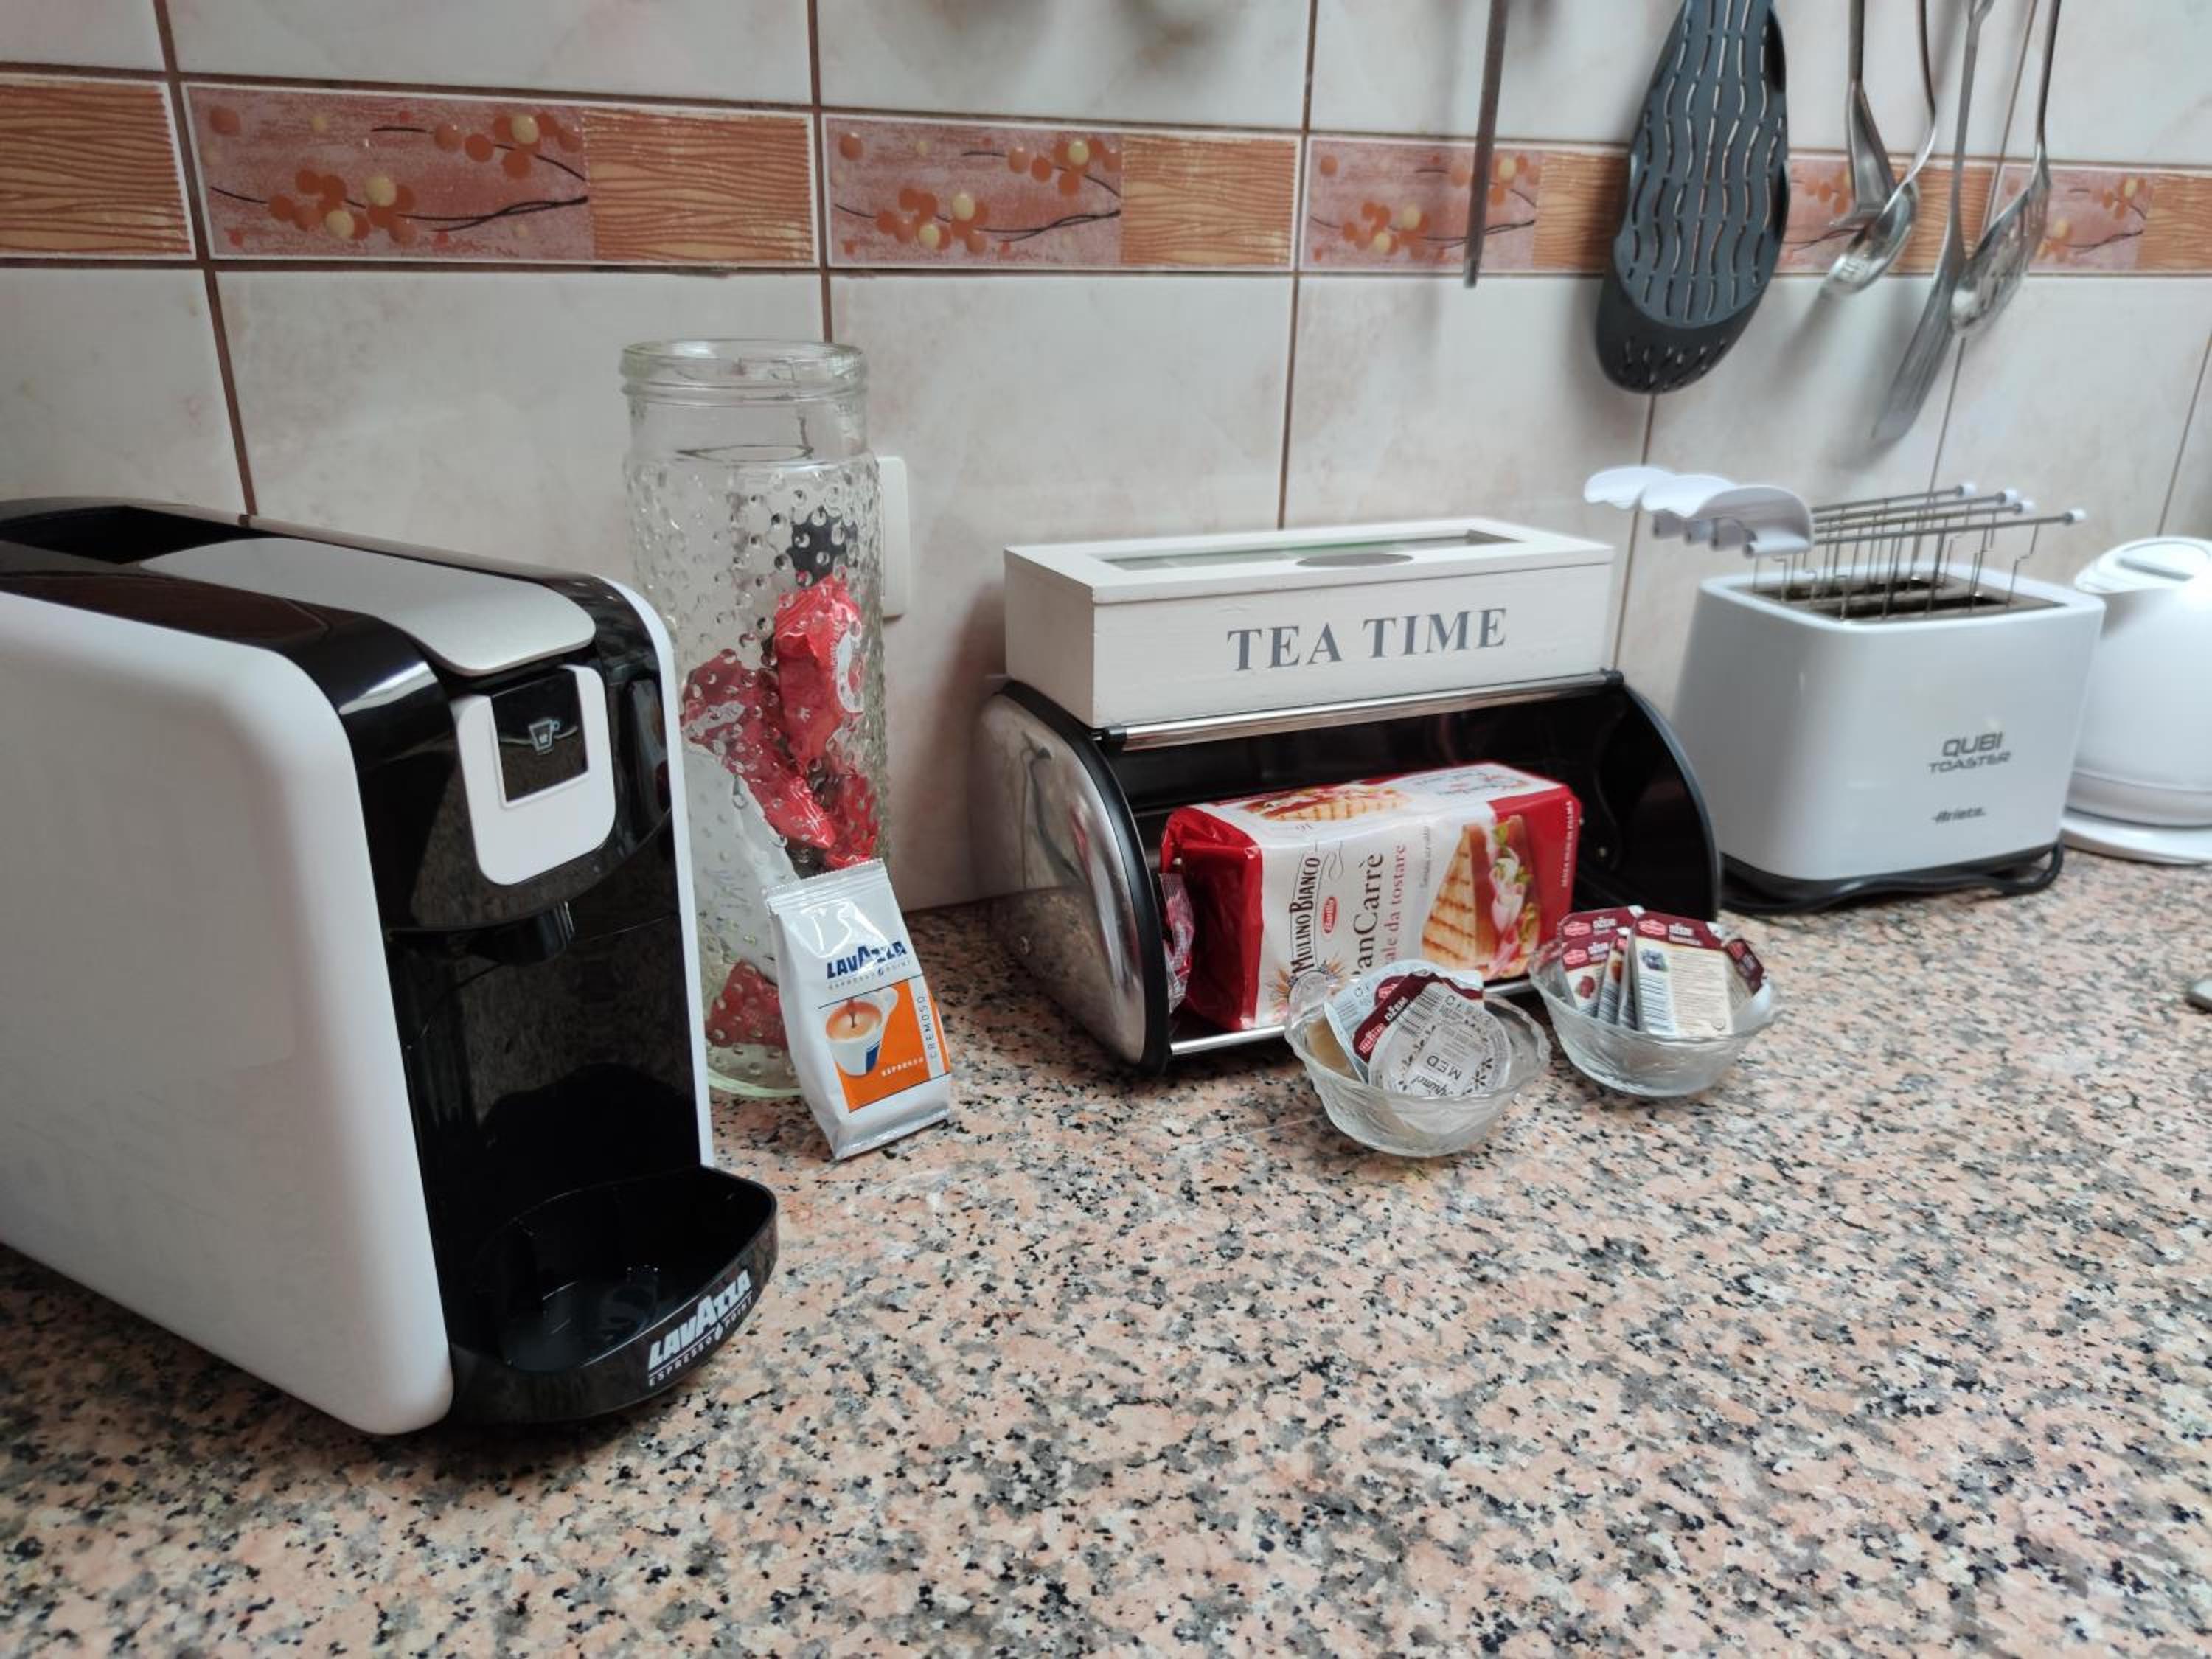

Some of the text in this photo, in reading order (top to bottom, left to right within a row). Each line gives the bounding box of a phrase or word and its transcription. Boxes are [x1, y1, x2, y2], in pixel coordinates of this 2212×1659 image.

[1227, 608, 1506, 671] TEA TIME
[1929, 751, 2011, 773] TOASTER
[1942, 731, 2003, 757] QUBI
[1289, 858, 1321, 914] BIANCO
[1391, 845, 1405, 905] tostare
[1291, 914, 1315, 974] MULINO
[1384, 912, 1400, 932] da
[826, 941, 907, 979] LAVAZZA
[917, 996, 937, 1059] CREMOSO
[1427, 1055, 1462, 1080] MED
[648, 1269, 751, 1371] LAVAZZA
[648, 1337, 712, 1387] ESPRESSO
